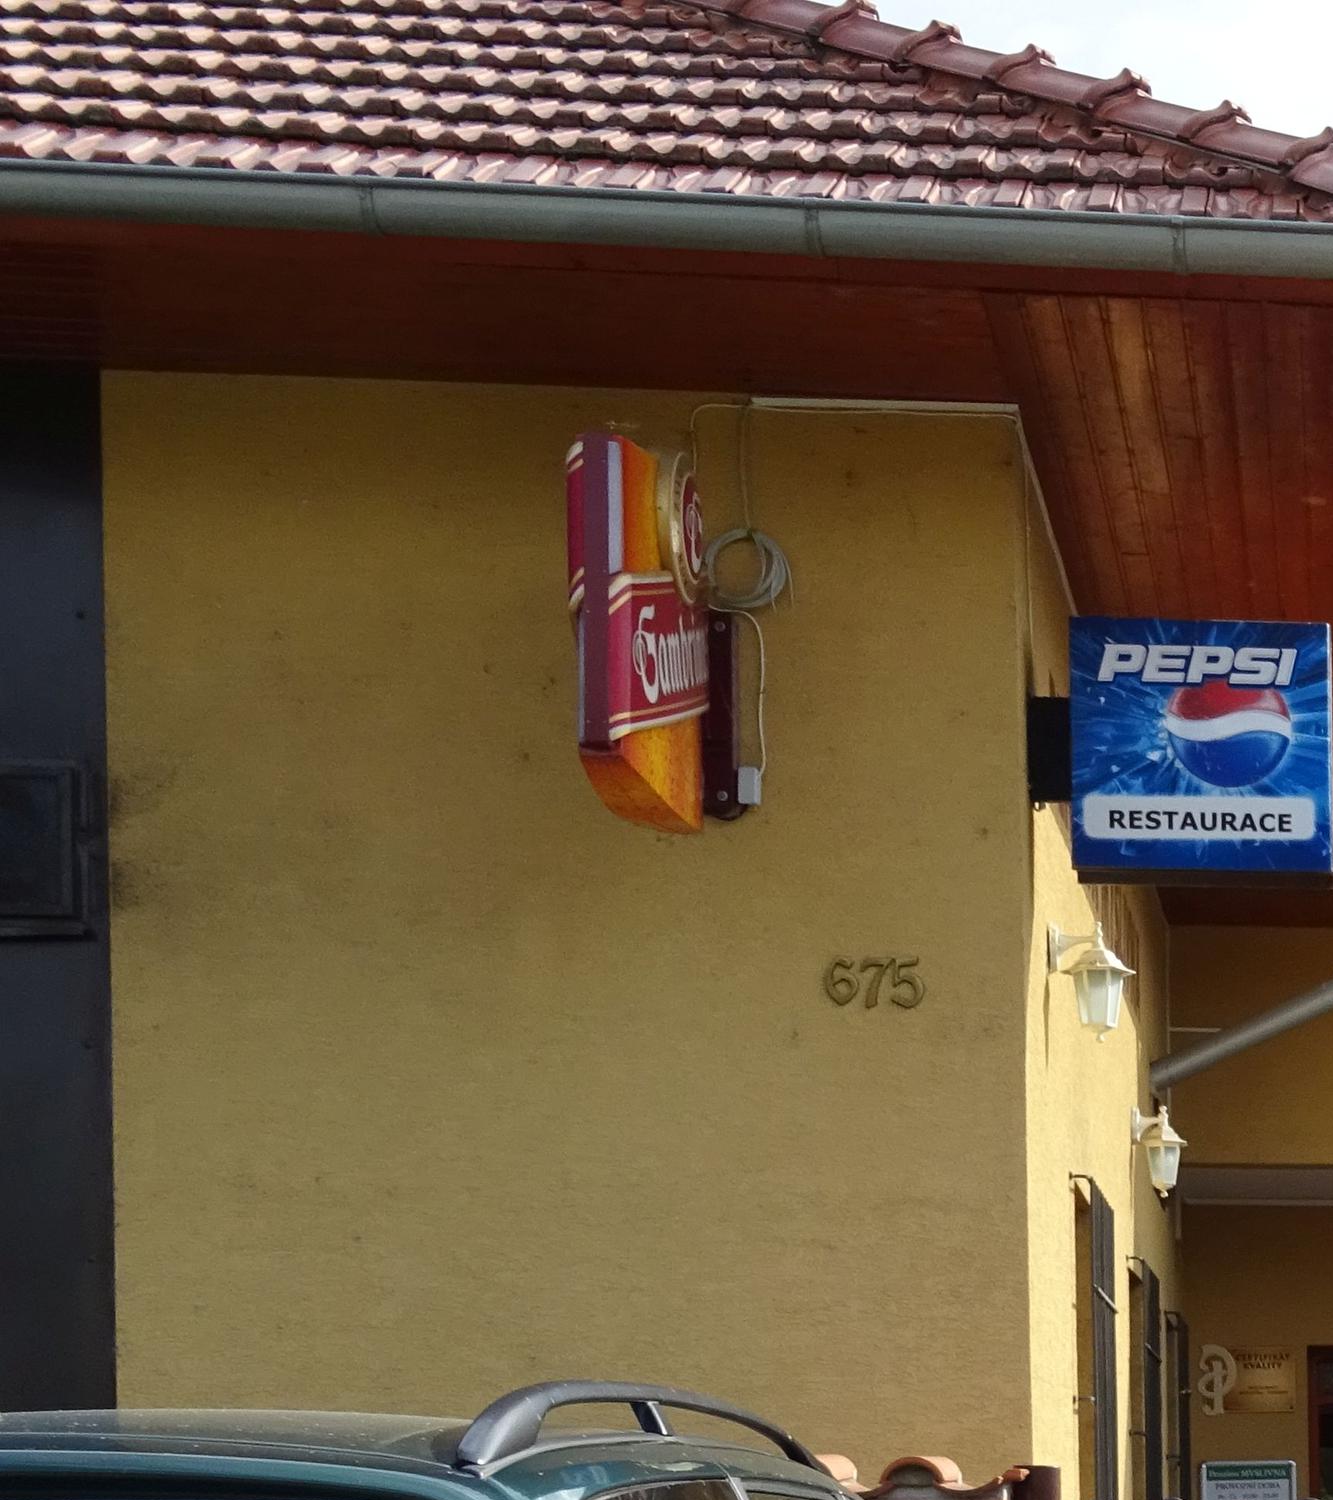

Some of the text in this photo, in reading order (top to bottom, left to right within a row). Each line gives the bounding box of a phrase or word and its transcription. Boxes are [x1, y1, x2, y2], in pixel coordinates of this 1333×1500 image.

[1097, 643, 1298, 686] PEPSI
[1108, 809, 1292, 833] RESTAURACE
[823, 955, 925, 1009] 675
